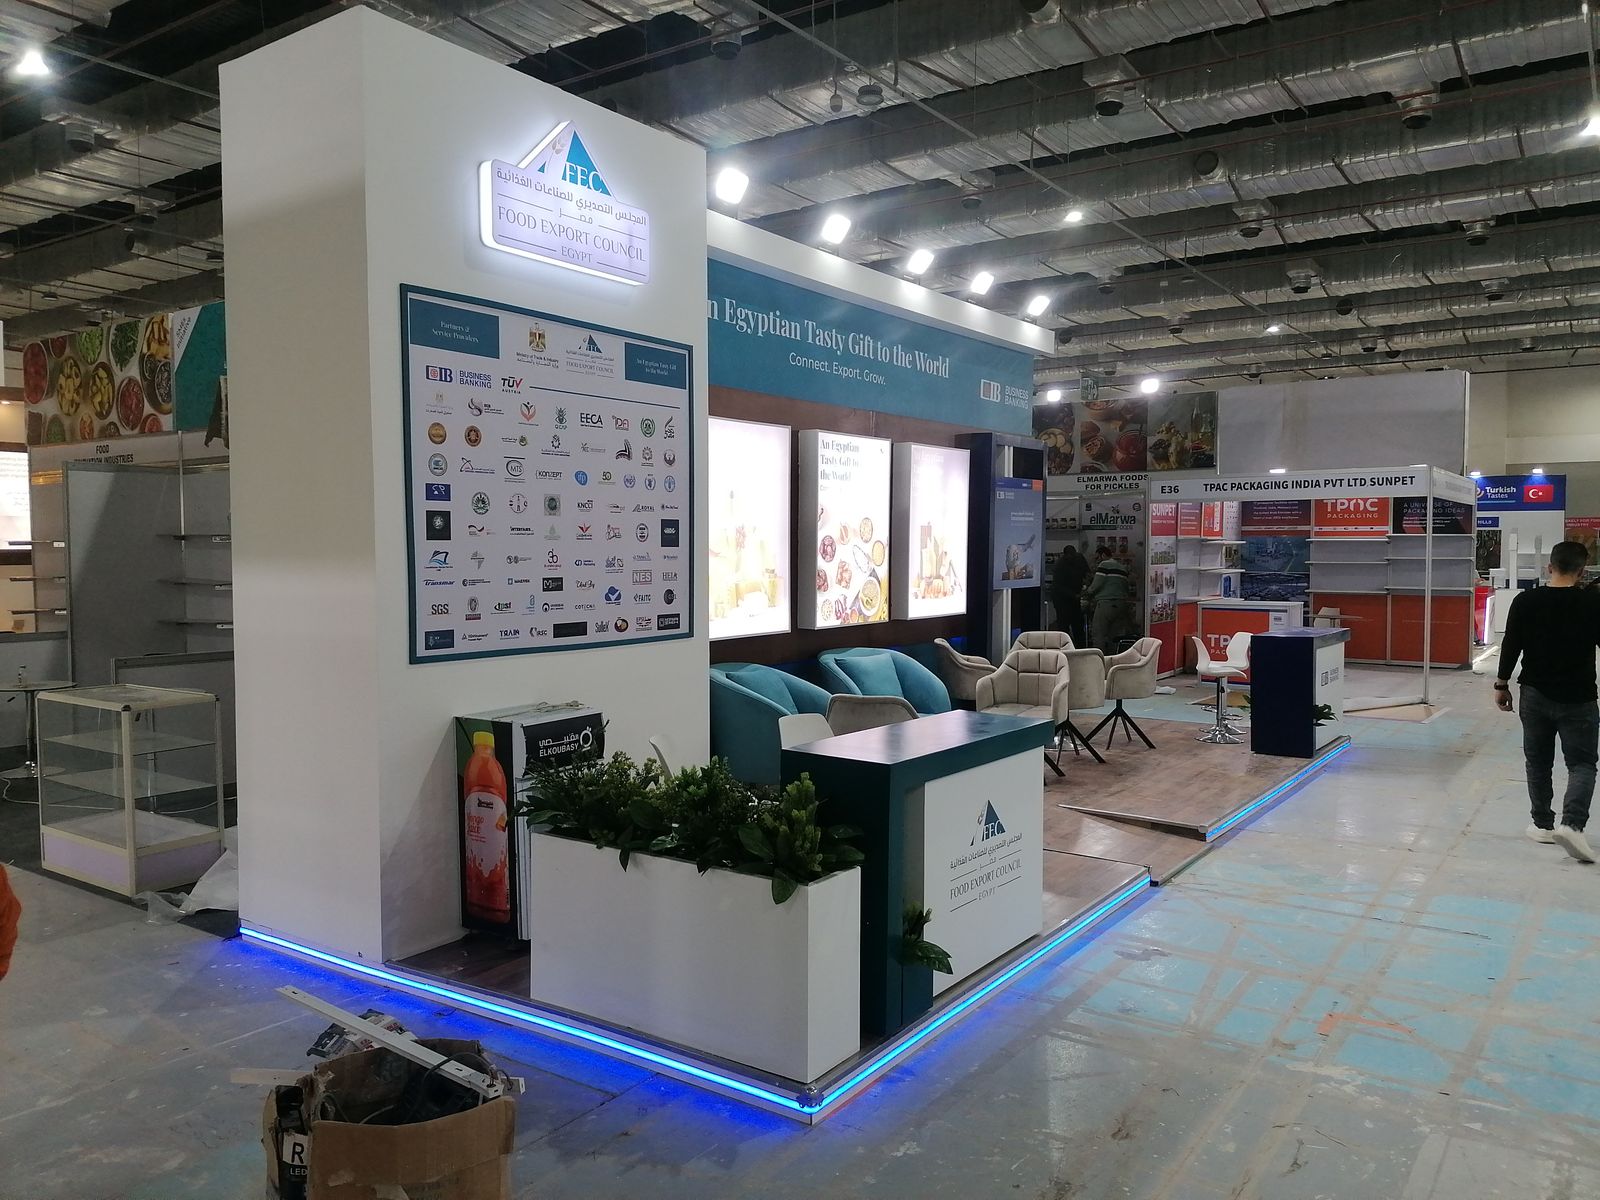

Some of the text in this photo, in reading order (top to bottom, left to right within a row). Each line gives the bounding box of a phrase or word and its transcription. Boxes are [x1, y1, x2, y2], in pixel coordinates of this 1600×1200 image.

[496, 168, 647, 226] المجلس التصديري للصناعات الغذائية
[498, 205, 647, 262] FOOD EXPORT COUNCIL
[561, 246, 593, 263] EGYPT
[440, 320, 463, 332] Partners
[432, 328, 480, 343] Service Providers
[707, 297, 949, 379] n Egyptian Tasty Gift to the World
[789, 352, 886, 385] Connect. Export. Grow.
[460, 370, 492, 382] BUSINESS
[460, 378, 492, 389] BANKING
[1004, 385, 1029, 400] BUSINESS
[1004, 396, 1029, 410] BANKING
[580, 413, 603, 425] EECA
[95, 444, 109, 454] FOOD
[820, 439, 860, 454] An Egyptian
[510, 465, 522, 473] MTS
[820, 469, 831, 480] the
[1077, 475, 1118, 483] ELMARWA
[1203, 482, 1228, 492] TPAC
[1230, 480, 1289, 491] PACKAGING
[1291, 479, 1321, 489] INDIA
[1323, 478, 1345, 488] PVT
[1370, 476, 1415, 487] SUNPET
[1085, 482, 1140, 491] FOR PICKLES
[1160, 485, 1180, 494] E36
[1152, 503, 1176, 516] SUNPET
[1089, 513, 1136, 525] elMarwa
[431, 604, 449, 615] SGS
[540, 742, 579, 757] ELKOUBASY
[950, 859, 1022, 900] FOOD EXPORT COUNCIL
[979, 887, 996, 901] EGYPT
[290, 1167, 307, 1176] LED
